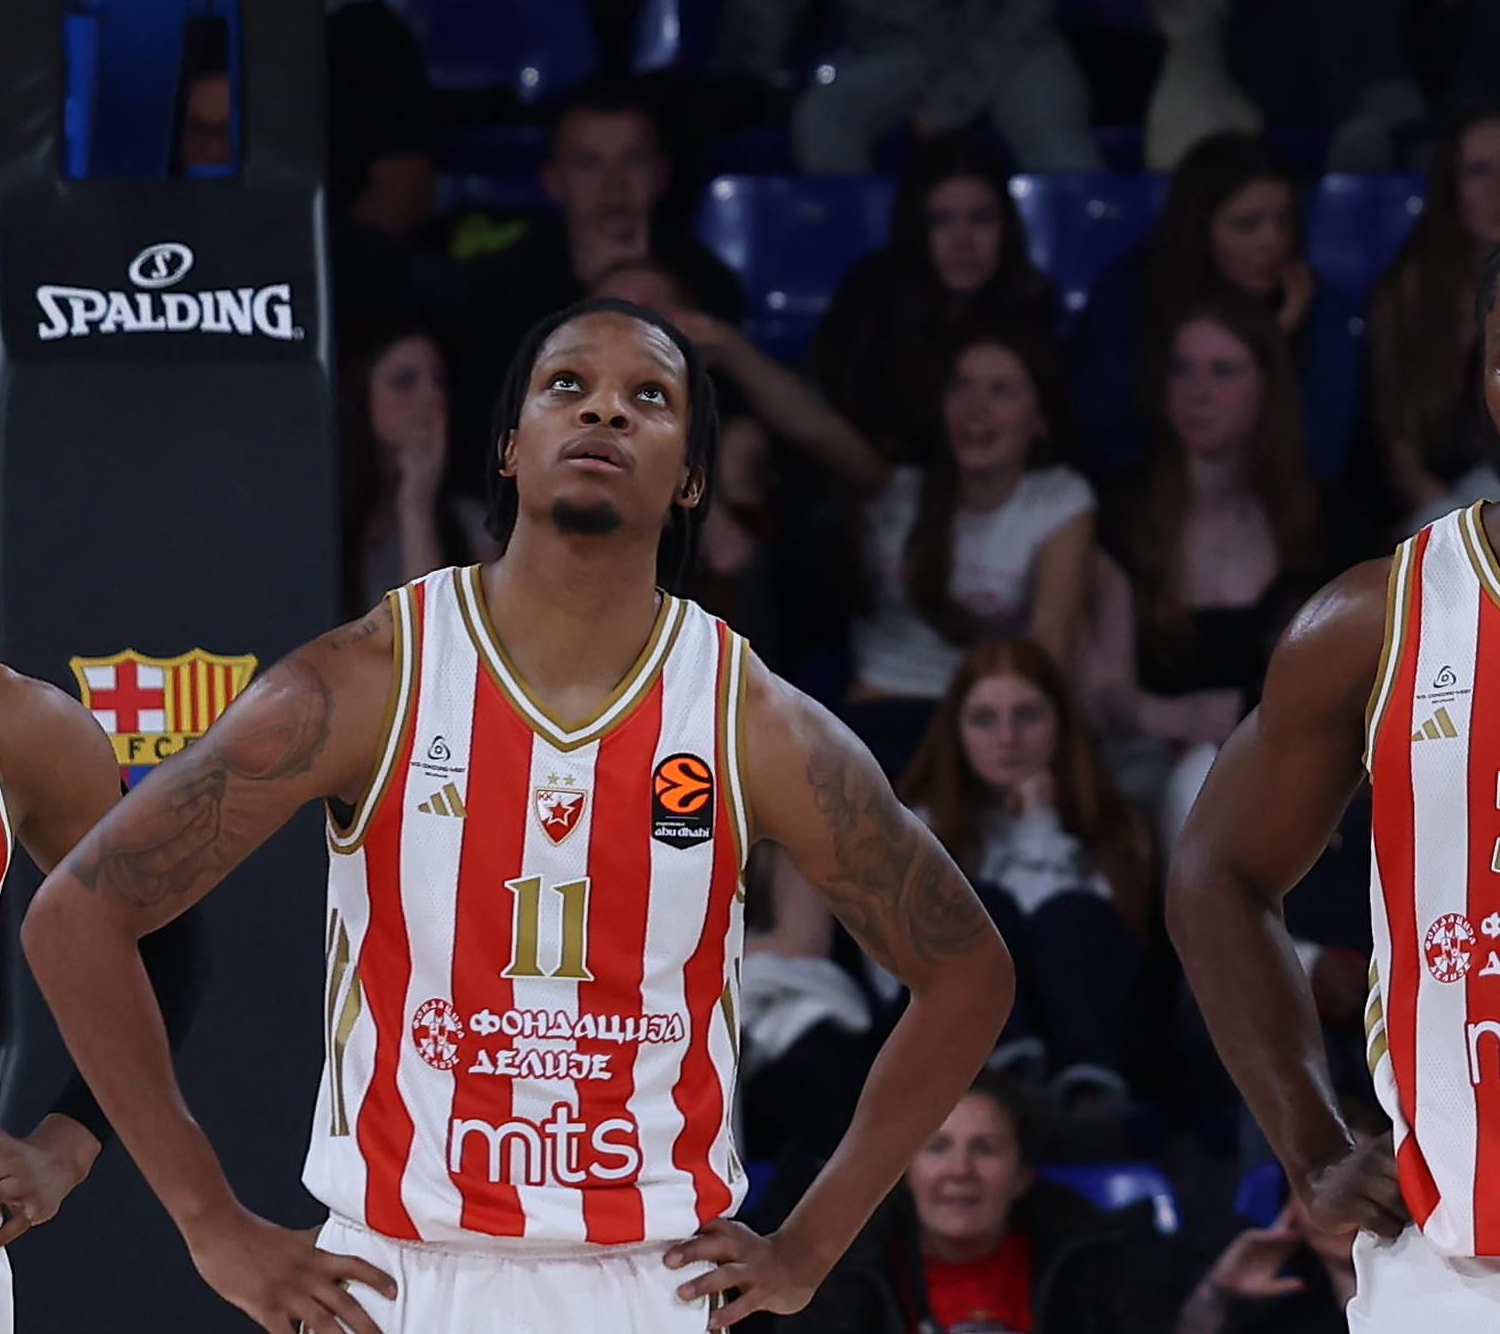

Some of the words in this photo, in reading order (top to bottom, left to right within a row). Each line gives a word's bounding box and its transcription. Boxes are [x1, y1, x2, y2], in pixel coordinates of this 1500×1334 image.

[36, 283, 293, 340] SPALDING
[655, 827, 676, 837] abu
[677, 827, 710, 837] dhabi
[500, 876, 595, 981] 11
[469, 1008, 685, 1044] ФОНДАЦИЈА
[468, 1049, 613, 1080] ДЕЛИЈЕ
[450, 1105, 640, 1186] mts
